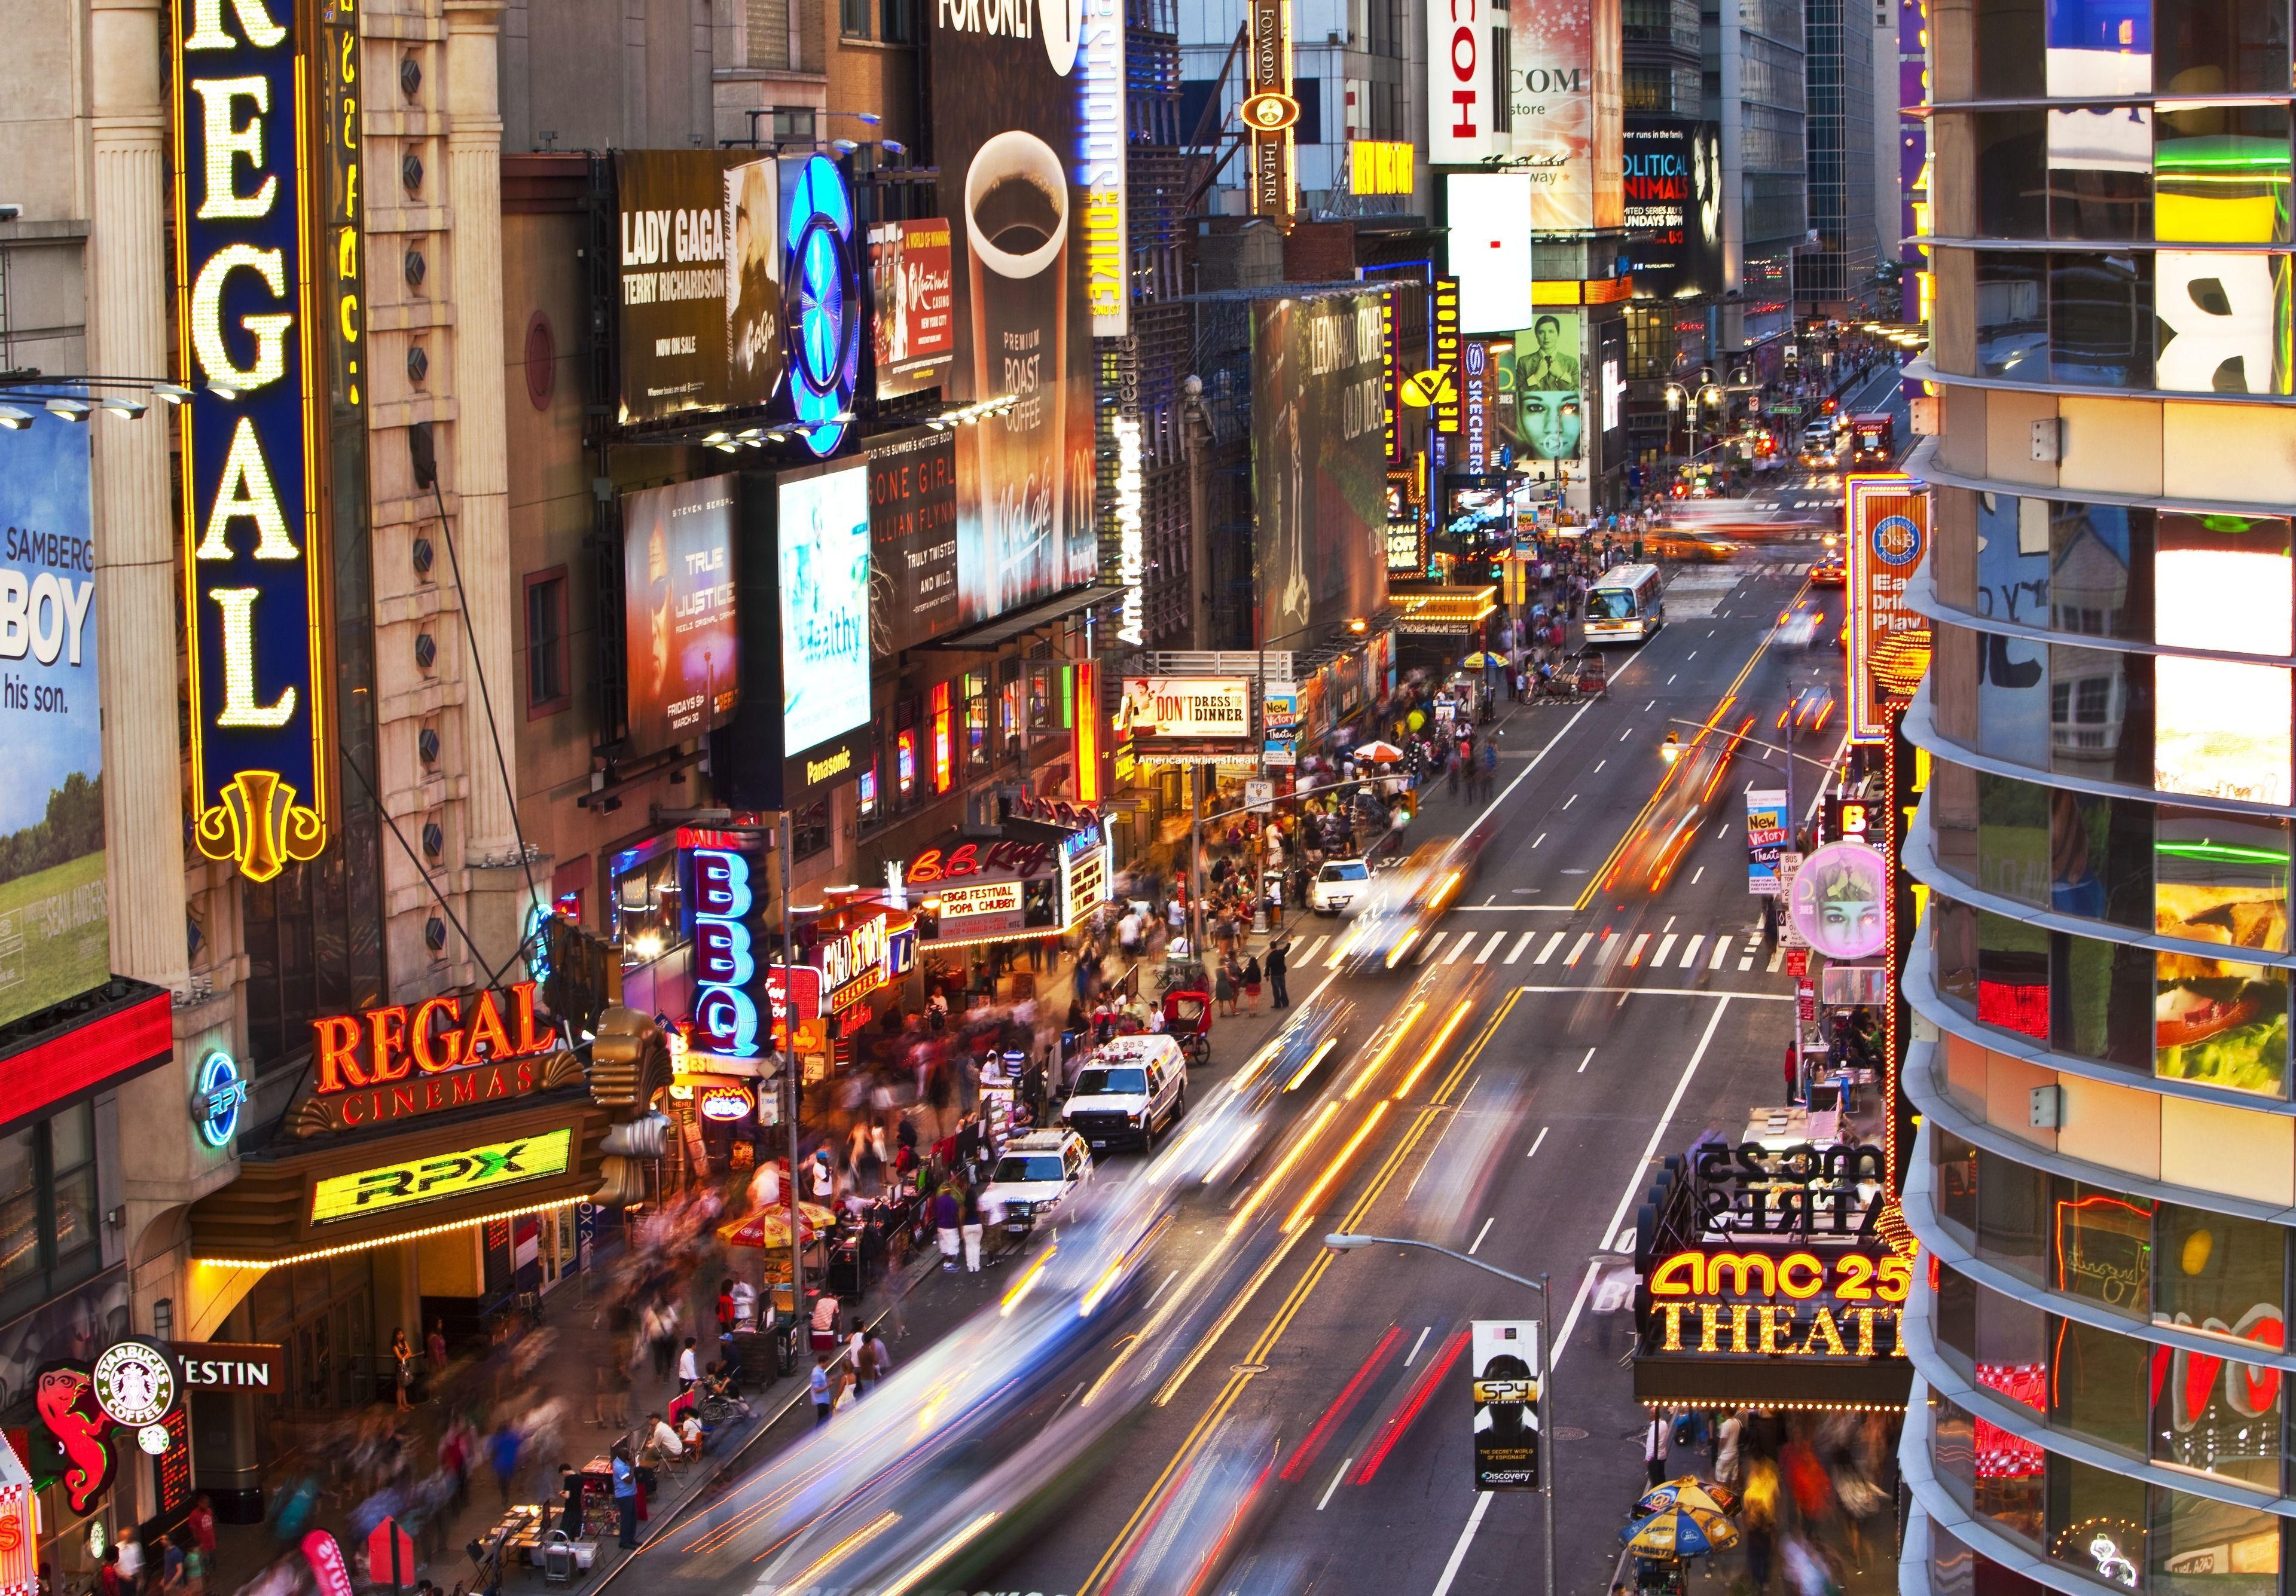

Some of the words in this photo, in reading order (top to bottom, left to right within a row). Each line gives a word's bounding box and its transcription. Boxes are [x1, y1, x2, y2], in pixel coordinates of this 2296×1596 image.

[1261, 9, 1274, 85] FOXWOODS
[1264, 140, 1277, 205] THEATRE
[1665, 215, 1683, 227] 10PM
[622, 210, 671, 266] LADY
[675, 209, 726, 263] GAGA
[910, 233, 924, 249] WORLD
[924, 232, 930, 247] OF
[931, 231, 950, 246] WINNING
[623, 272, 658, 305] TERRY
[660, 268, 725, 302] RICHARDSON
[932, 295, 949, 310] CASINO
[929, 316, 938, 328] YORK
[939, 315, 947, 326] CITY
[656, 339, 670, 357] NOW
[671, 337, 680, 355] ON
[681, 336, 696, 354] SALE
[1004, 329, 1040, 351] PREMIUM
[1311, 313, 1355, 376] LEONARD
[1357, 305, 1385, 365] COHEN
[1005, 354, 1040, 395] ROAST
[1006, 396, 1041, 433] COFFEE
[1344, 383, 1361, 441] OLD
[1364, 375, 1387, 433] IDEAS
[1468, 380, 1483, 475] SKECHERS
[878, 443, 890, 458] THIS
[891, 436, 917, 454] SUMMER'S
[918, 434, 939, 449] HOTTEST
[939, 430, 953, 444] BOOK
[919, 455, 955, 494] GIRL
[672, 505, 703, 518] STEVEN
[920, 499, 955, 530] FLYNN
[1517, 524, 1537, 533] Victory
[7, 526, 94, 573] SAMBERG
[929, 539, 955, 563] TWISTED
[1878, 533, 1915, 549] D&B
[685, 547, 724, 576] TRUE
[920, 576, 934, 595] AND
[1873, 574, 1911, 591] Ea
[675, 580, 736, 619] JUSTICE
[1873, 594, 1907, 611] Drin
[0, 568, 94, 668] BOY
[695, 615, 718, 630] ORIGINAL
[5, 673, 29, 711] his
[34, 684, 68, 714] son.
[667, 696, 694, 718] FRIDAYS
[1156, 696, 1192, 722] DON'T
[1195, 696, 1231, 708] DRESS
[1195, 708, 1244, 722] DINNER
[1266, 702, 1287, 714] New
[673, 715, 689, 730] MARCH
[690, 714, 699, 726] 30
[1265, 714, 1294, 727] Victory
[807, 745, 851, 787] Panasonic
[1138, 755, 1260, 765] AmericanAirlinesTheatr
[1749, 815, 1776, 830] New
[677, 827, 740, 850] DALLAS
[1749, 830, 1785, 846] Victory
[982, 841, 1057, 879] King
[1750, 848, 1780, 862] Theate
[942, 891, 967, 903] CBGB
[970, 886, 1013, 900] FESTIVAL
[949, 903, 973, 915] POPA
[979, 898, 1016, 911] CHUBBY
[955, 919, 987, 928] LUCILLE'S
[694, 849, 759, 1056] BBQ
[823, 934, 852, 993] COLD
[313, 981, 556, 1095] REGAL
[206, 1079, 248, 1117] RPX
[342, 1062, 533, 1125] CINEMAS
[356, 1144, 529, 1206] RPX
[1835, 1255, 1912, 1302] 25
[98, 1346, 170, 1385] STARBUCKS
[179, 1355, 269, 1387] ESTIN
[1482, 1382, 1529, 1401] SPY
[106, 1399, 163, 1423] COFFEE
[1484, 1471, 1530, 1482] Discovery
[1631, 1545, 1672, 1557] SABRETT
